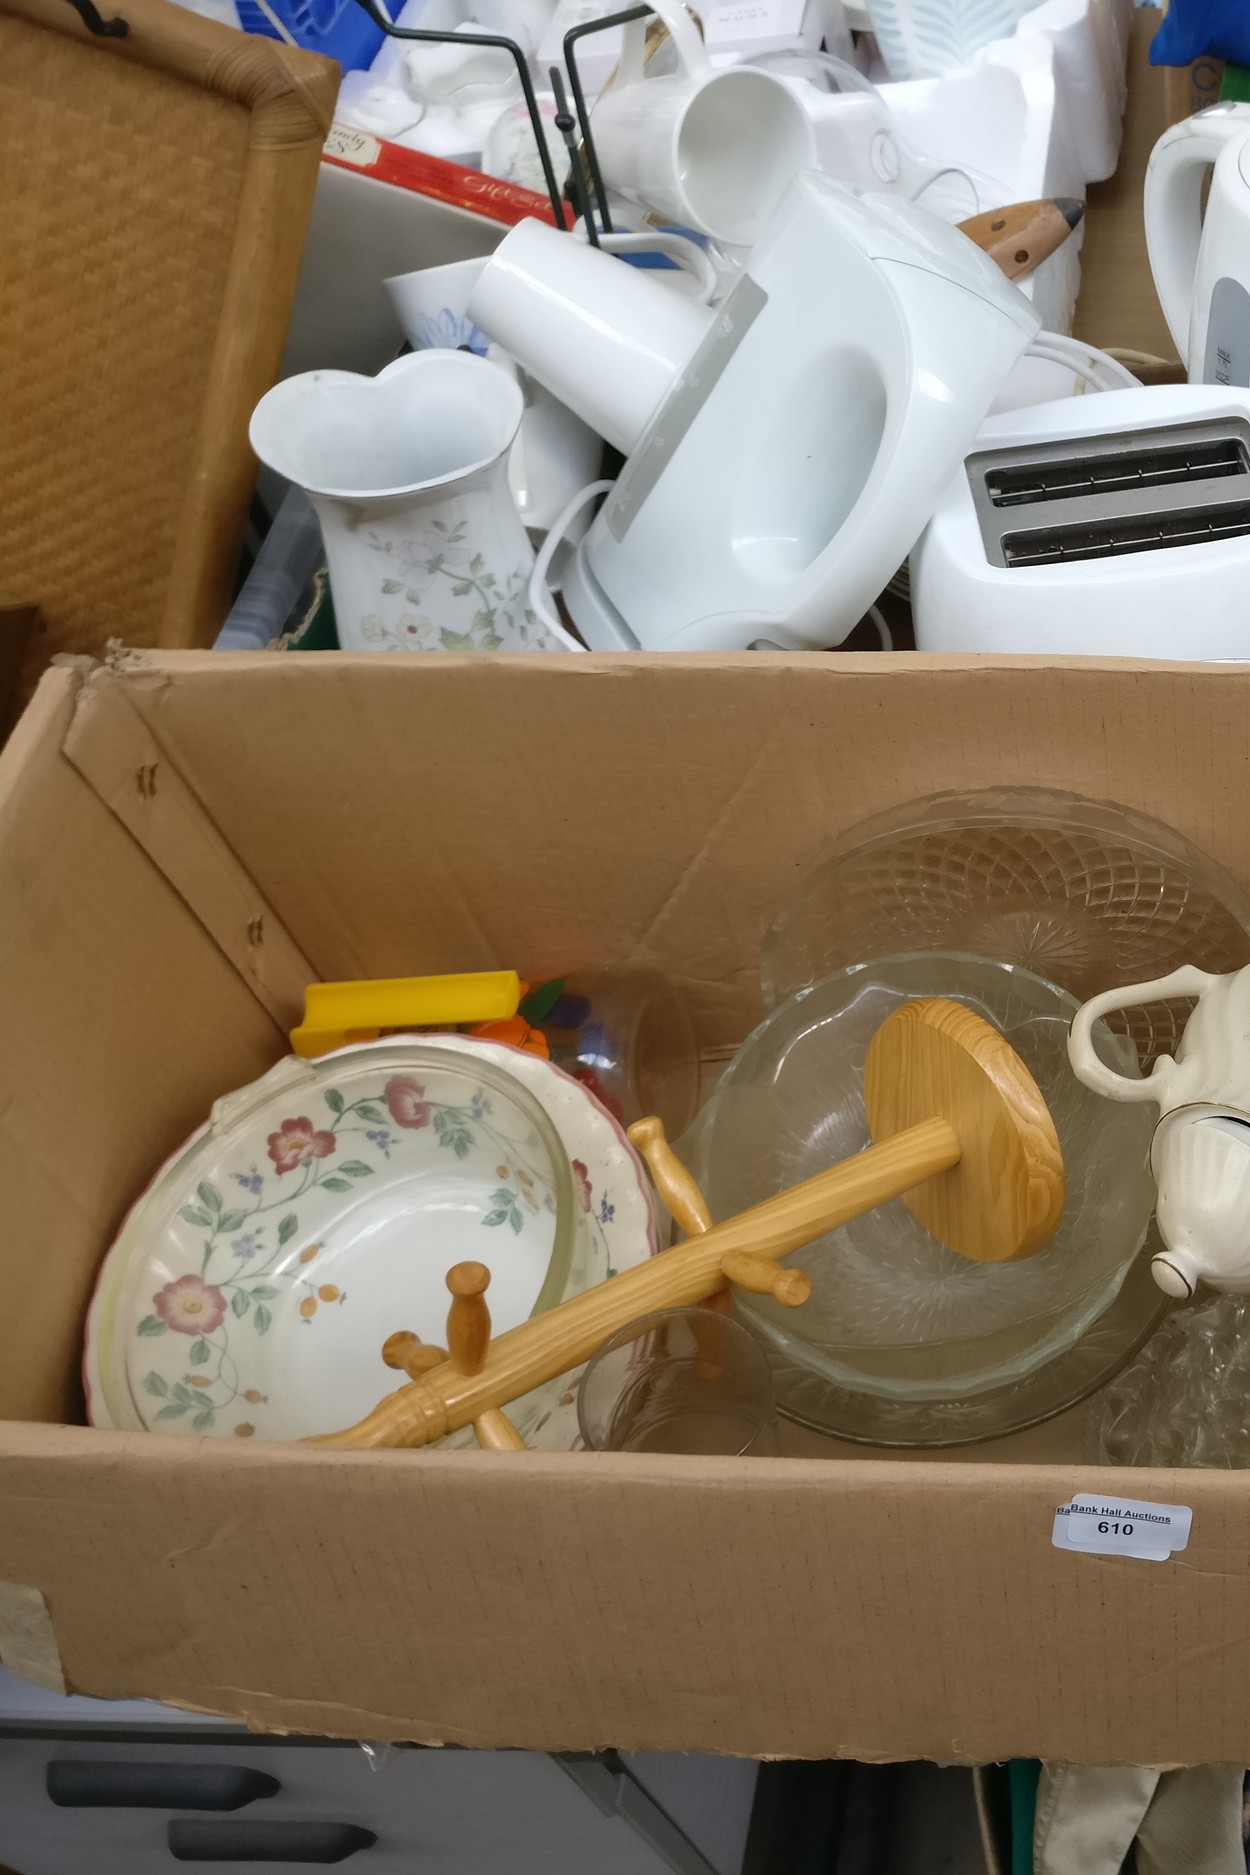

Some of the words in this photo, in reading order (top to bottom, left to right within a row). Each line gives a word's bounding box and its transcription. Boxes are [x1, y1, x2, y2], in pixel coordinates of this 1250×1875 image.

[1070, 1503, 1098, 1514] Bank
[1101, 1507, 1122, 1517] Hall
[1124, 1510, 1171, 1524] Auctions
[1097, 1521, 1134, 1536] 610
